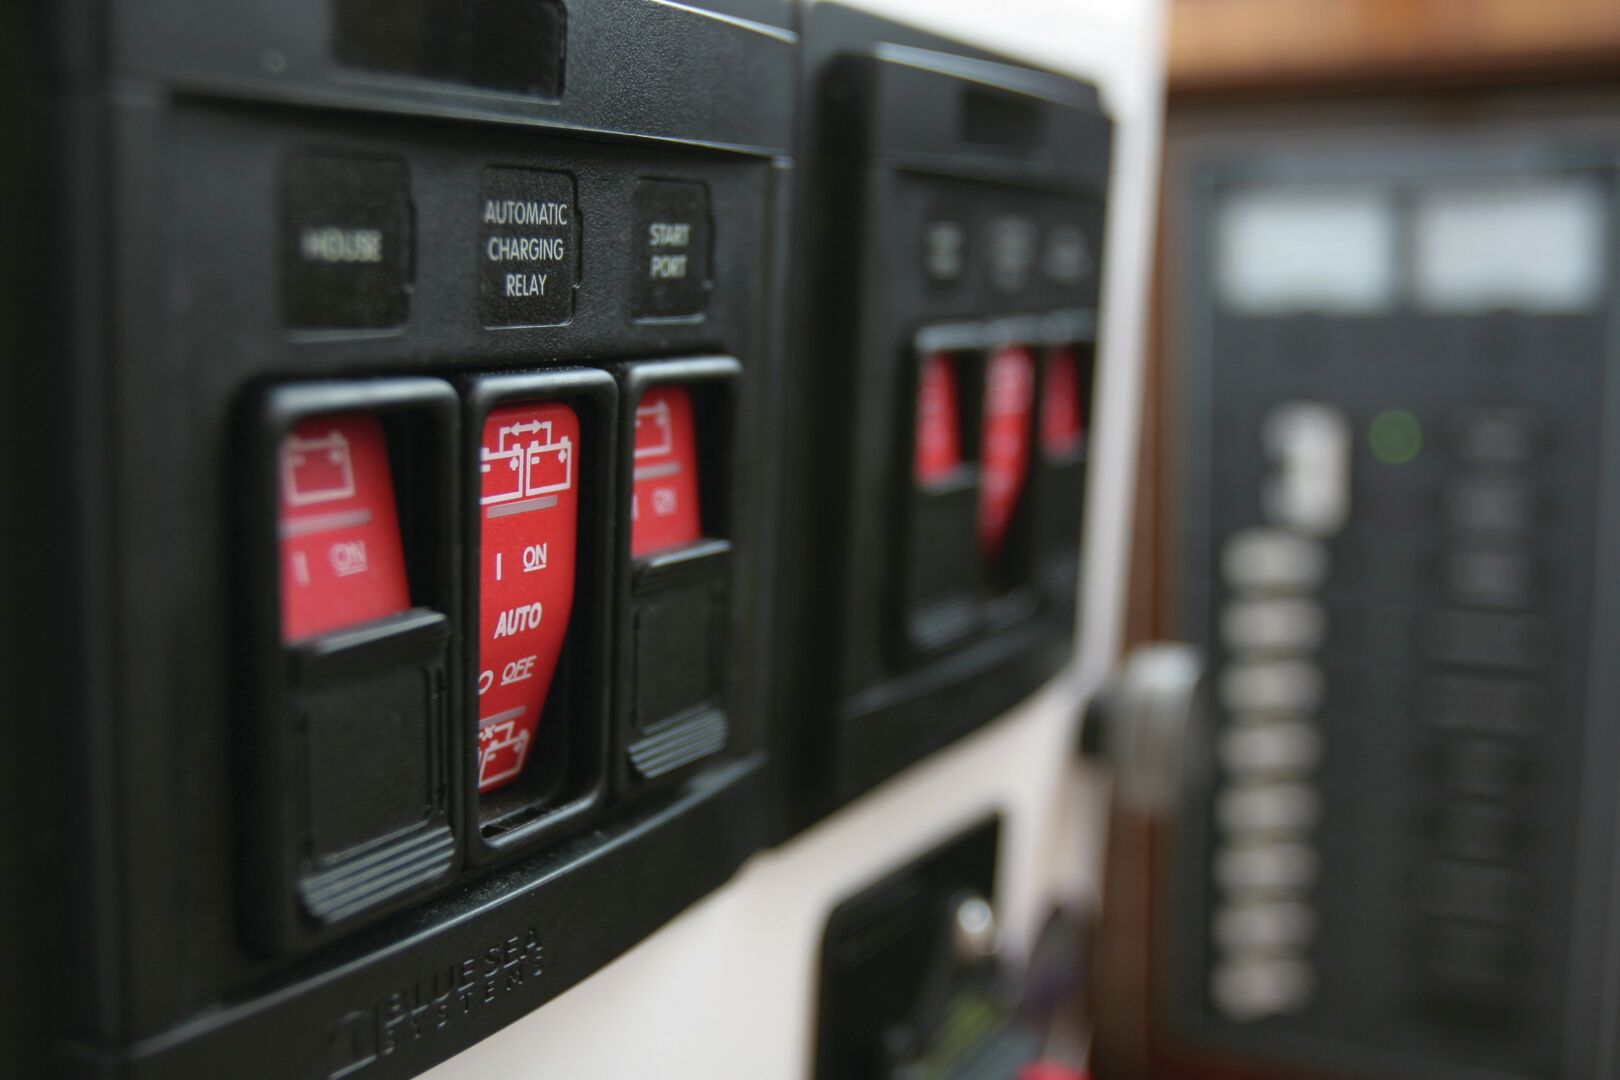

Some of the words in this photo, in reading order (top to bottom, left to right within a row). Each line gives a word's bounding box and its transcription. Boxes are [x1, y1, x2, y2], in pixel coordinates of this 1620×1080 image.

[484, 201, 568, 226] AUTOMATIC
[303, 230, 382, 263] HOUSE
[488, 237, 564, 262] CHARGING
[649, 224, 690, 246] START
[650, 255, 687, 278] PORT
[506, 274, 547, 297] RELAY
[653, 487, 676, 516] ON
[329, 540, 369, 576] ON
[522, 543, 548, 572] ON
[494, 602, 543, 639] AUTO
[501, 655, 537, 685] OFF
[485, 928, 544, 978] SEA
